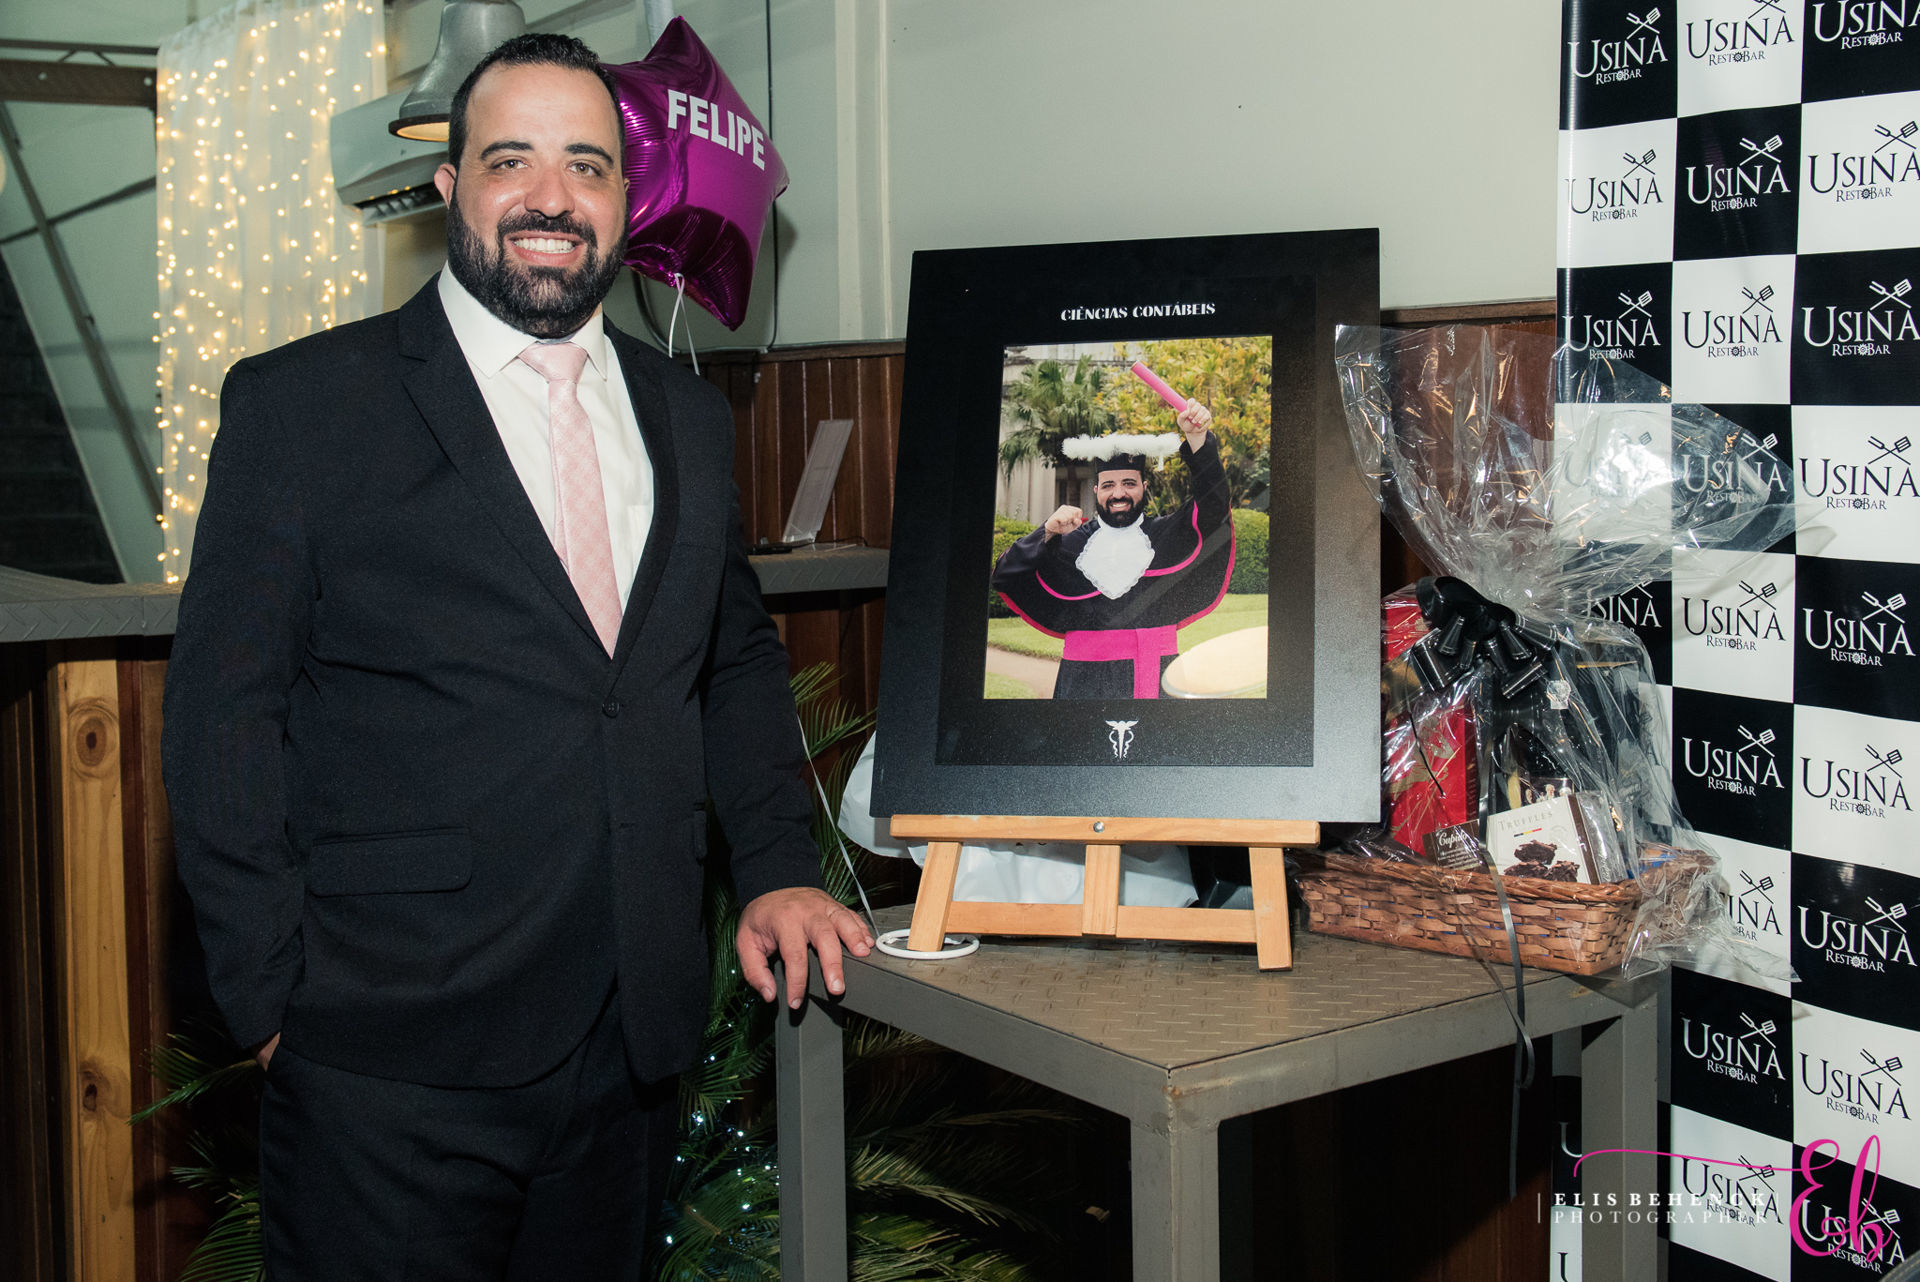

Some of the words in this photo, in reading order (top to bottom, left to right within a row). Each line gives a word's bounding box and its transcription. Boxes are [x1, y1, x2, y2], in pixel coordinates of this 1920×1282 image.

[1567, 35, 1669, 78] USINA
[1686, 15, 1795, 59] USINA
[667, 88, 765, 171] FELIPE
[1565, 176, 1664, 214] USINA
[1686, 164, 1792, 204] USINA
[1132, 301, 1216, 318] CONTÁBEIS
[1682, 310, 1783, 349] USINA
[1801, 306, 1920, 347] USINA
[1562, 314, 1662, 352] USINA
[1799, 458, 1920, 498] USINA
[1593, 596, 1662, 628] SINA
[1681, 597, 1787, 641] USINA
[1803, 608, 1917, 657] USINA
[1682, 737, 1785, 789] USINA
[1800, 756, 1913, 812] USINA
[1798, 905, 1918, 967] USINA
[1681, 1017, 1786, 1081] USINA
[1799, 1052, 1912, 1120] USINA
